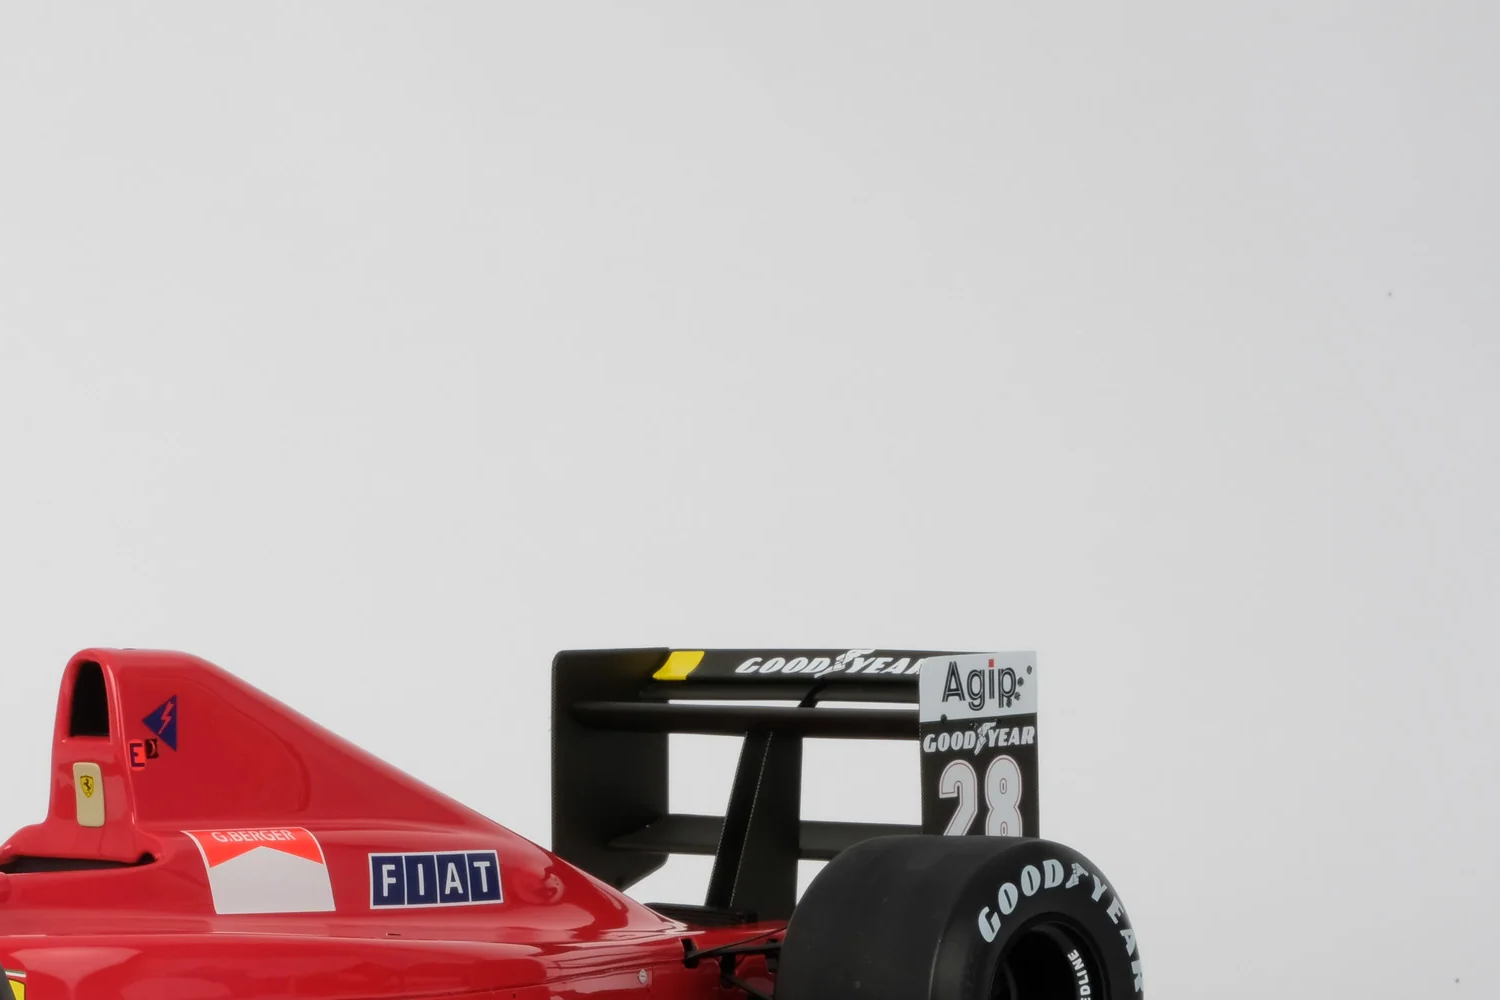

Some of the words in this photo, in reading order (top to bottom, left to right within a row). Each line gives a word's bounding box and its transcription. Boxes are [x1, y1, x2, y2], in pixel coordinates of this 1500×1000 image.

[942, 659, 1017, 711] Agip
[923, 723, 1035, 755] GOODYEAR
[939, 755, 1023, 837] 28
[211, 829, 297, 843] G.BERGER
[382, 861, 491, 897] FIAT
[978, 859, 1143, 992] GOODYEAR
